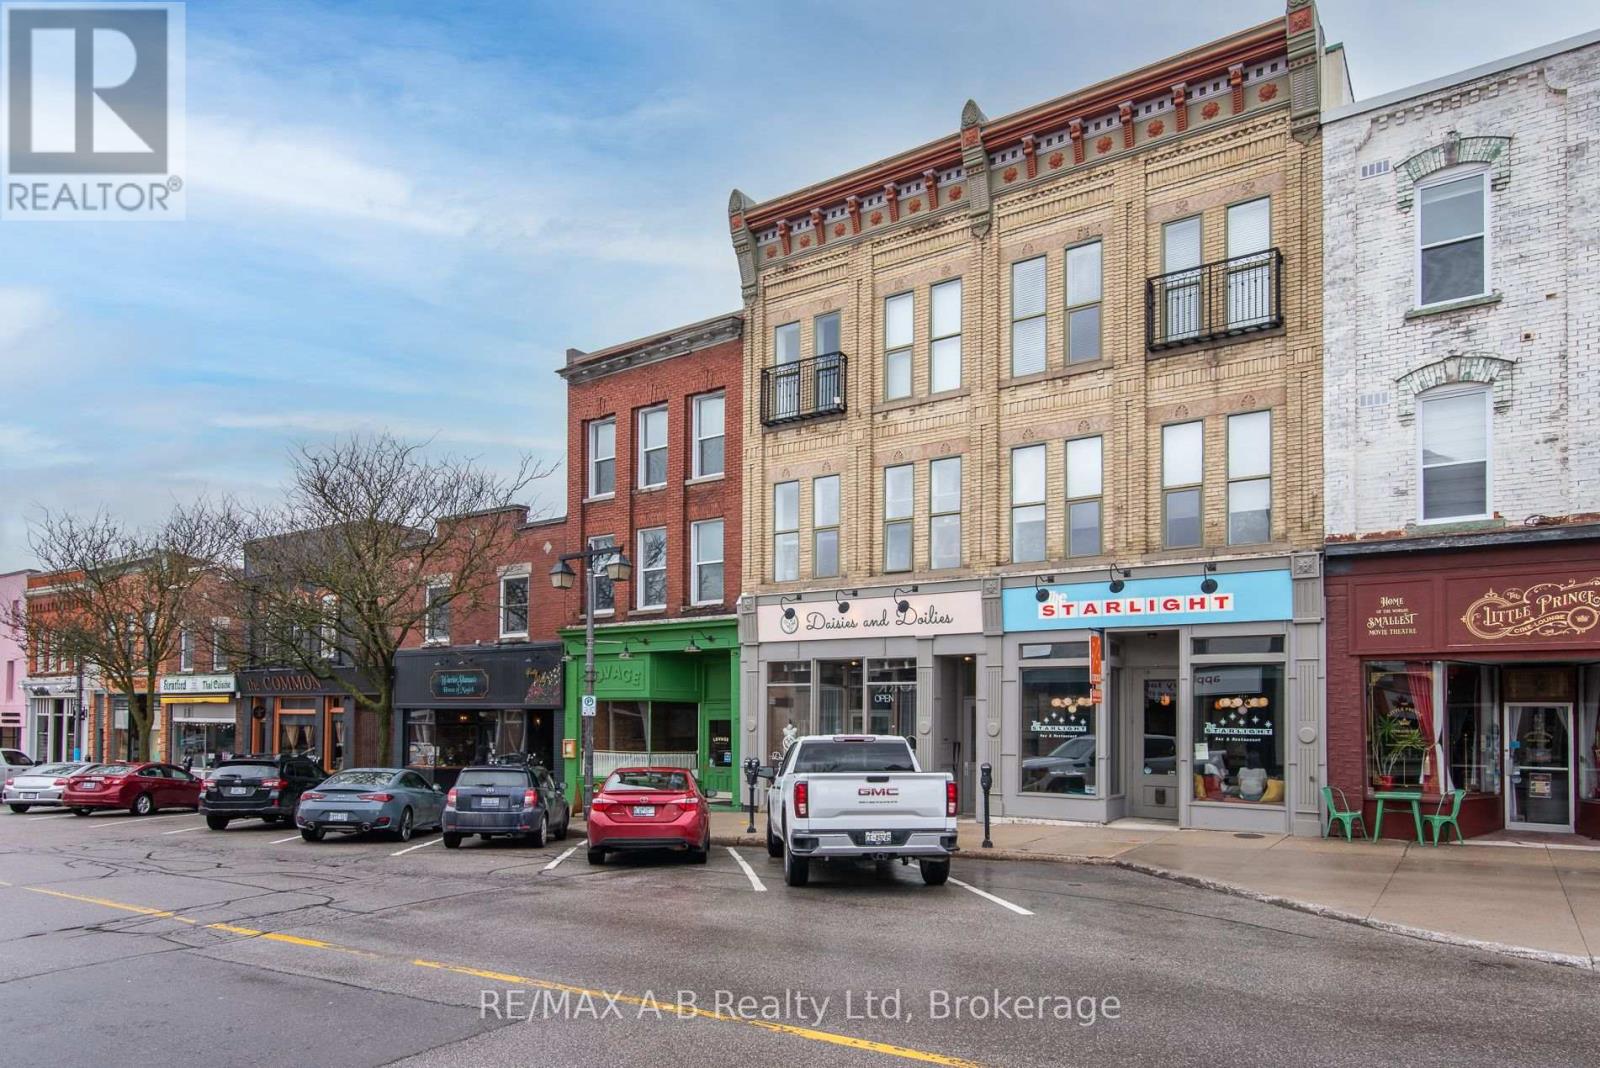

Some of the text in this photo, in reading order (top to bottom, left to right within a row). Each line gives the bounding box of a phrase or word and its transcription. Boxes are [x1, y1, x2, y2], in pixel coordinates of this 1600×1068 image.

[1041, 595, 1230, 617] STARLIGHT
[1380, 596, 1404, 608] HOME
[1483, 590, 1600, 628] LITTLE PRINCE
[806, 604, 954, 631] Daisies and Doilies
[1366, 612, 1419, 629] SMALLEST
[1513, 613, 1566, 635] CINE-LOUNGE
[583, 663, 642, 687] OVAGE
[163, 679, 187, 691] Stratford
[874, 694, 895, 703] OPEN
[1205, 727, 1272, 735] STARLIGHT
[858, 788, 899, 796] GMC
